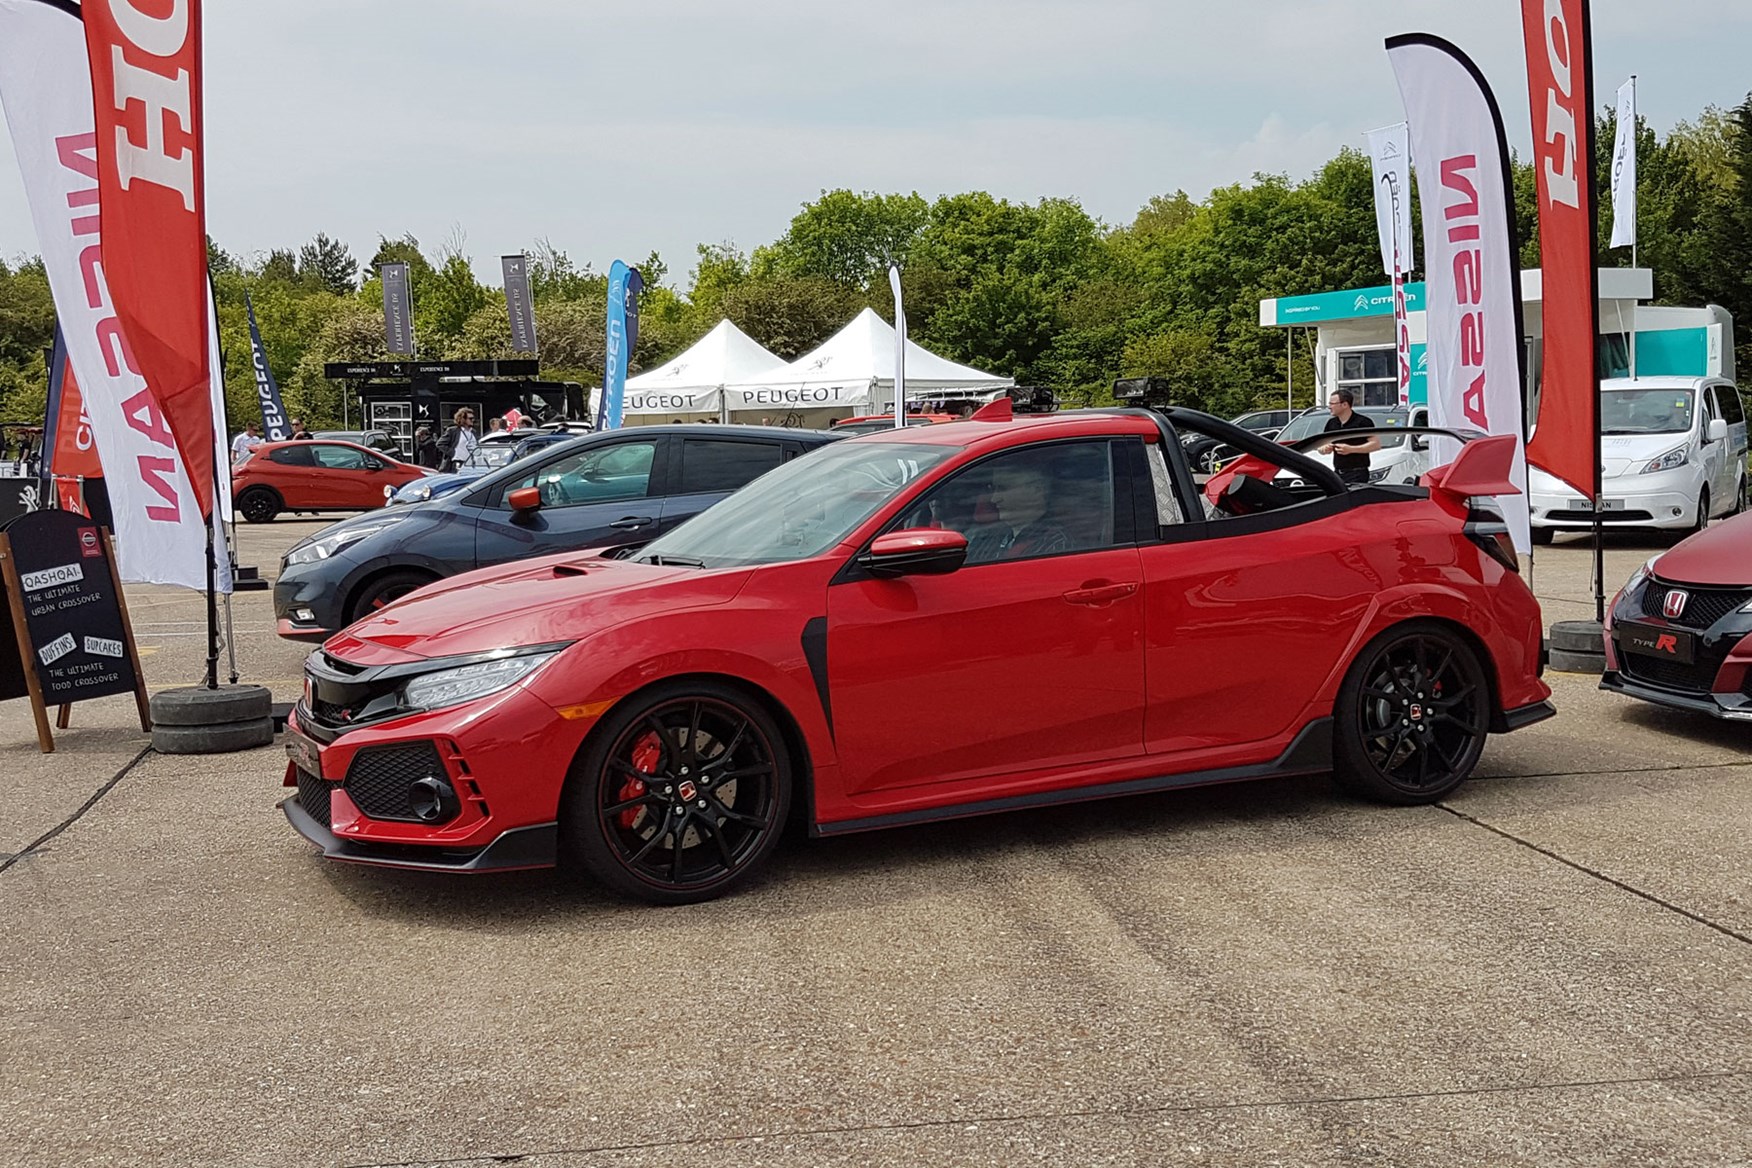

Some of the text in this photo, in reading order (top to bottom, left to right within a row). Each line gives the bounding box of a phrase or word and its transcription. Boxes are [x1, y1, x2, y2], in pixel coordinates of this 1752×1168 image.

[622, 394, 697, 409] EUGEOT
[743, 387, 843, 404] PEUGEOT
[24, 567, 78, 588] QASHQAI
[27, 585, 80, 603] THE ULTIMATE
[31, 592, 101, 616] URBAN CROSSOVER
[1633, 633, 1678, 654] TYPE R
[49, 662, 104, 678] THE ULTIMATE
[52, 673, 119, 691] FOOD CROSSOVER
